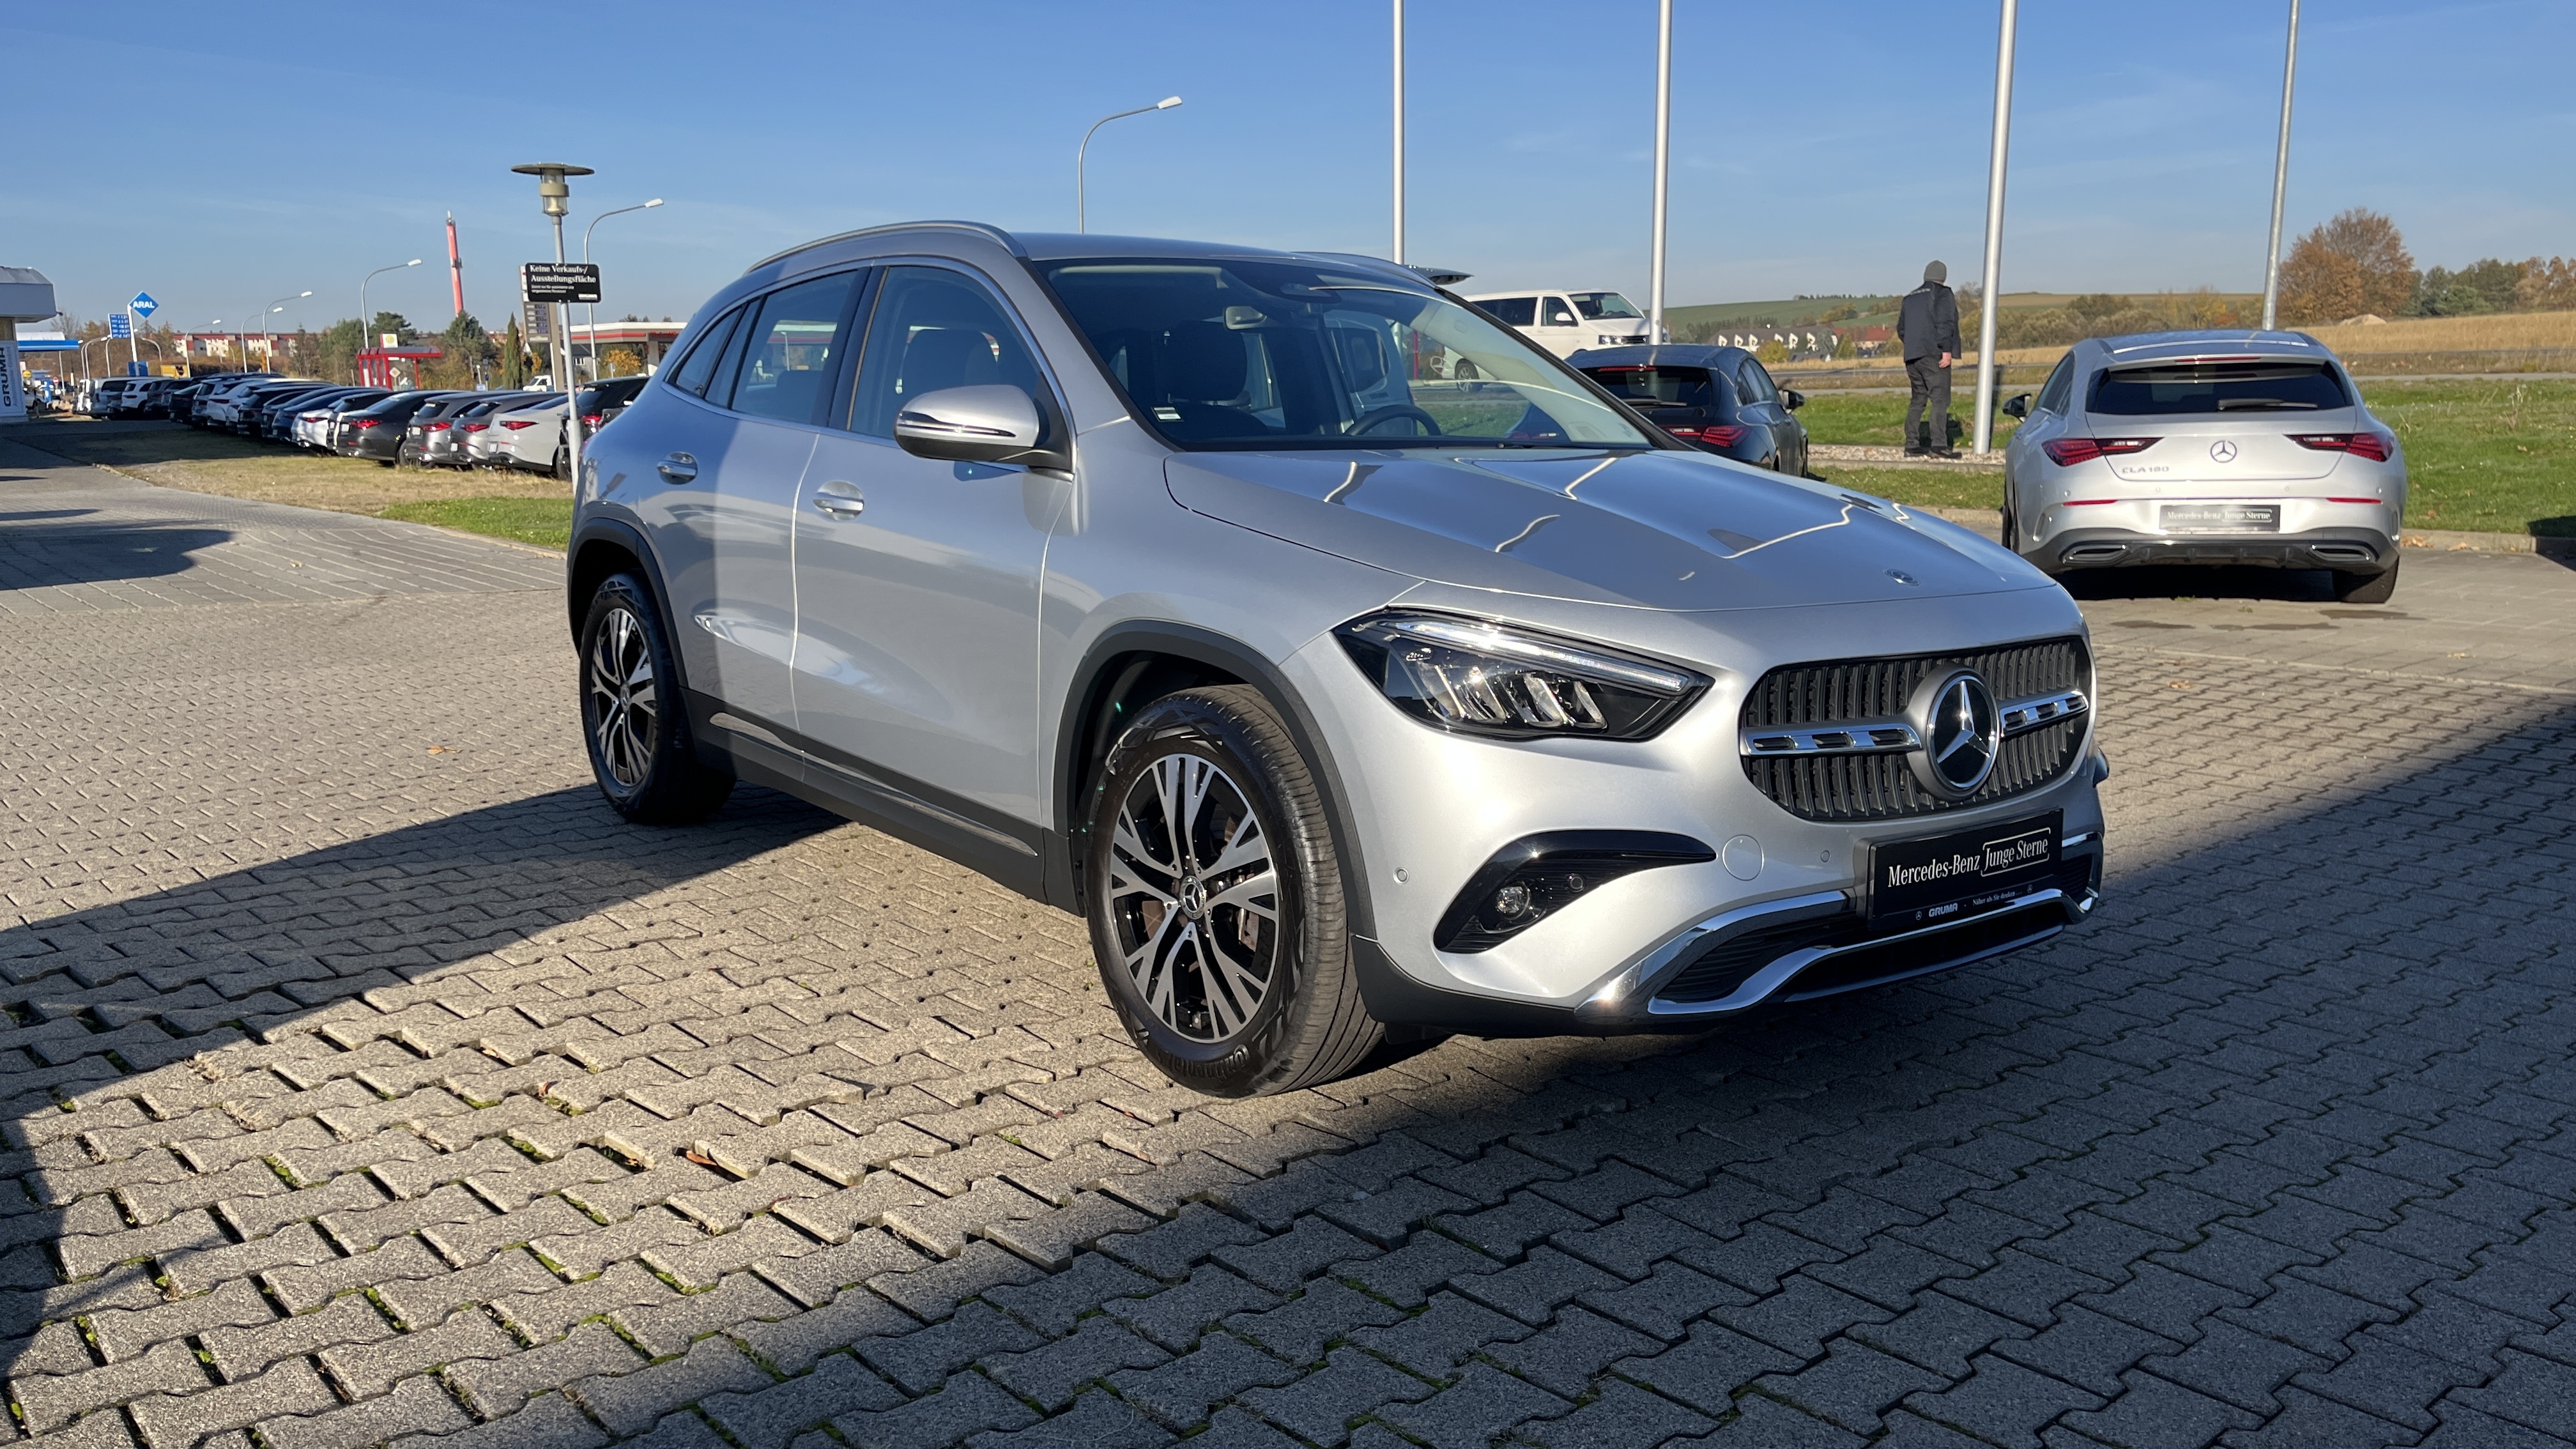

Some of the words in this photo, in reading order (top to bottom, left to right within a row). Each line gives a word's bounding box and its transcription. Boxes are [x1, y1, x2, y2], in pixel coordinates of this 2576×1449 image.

[530, 264, 550, 273] Keine
[531, 275, 596, 284] Ausstellungsfläche
[2246, 511, 2271, 520] Sterne
[1888, 854, 1981, 887] Mercedes-Benz
[1984, 847, 2014, 871] Junge
[2016, 839, 2048, 860] Sterne
[1928, 903, 1958, 917] GRUMA
